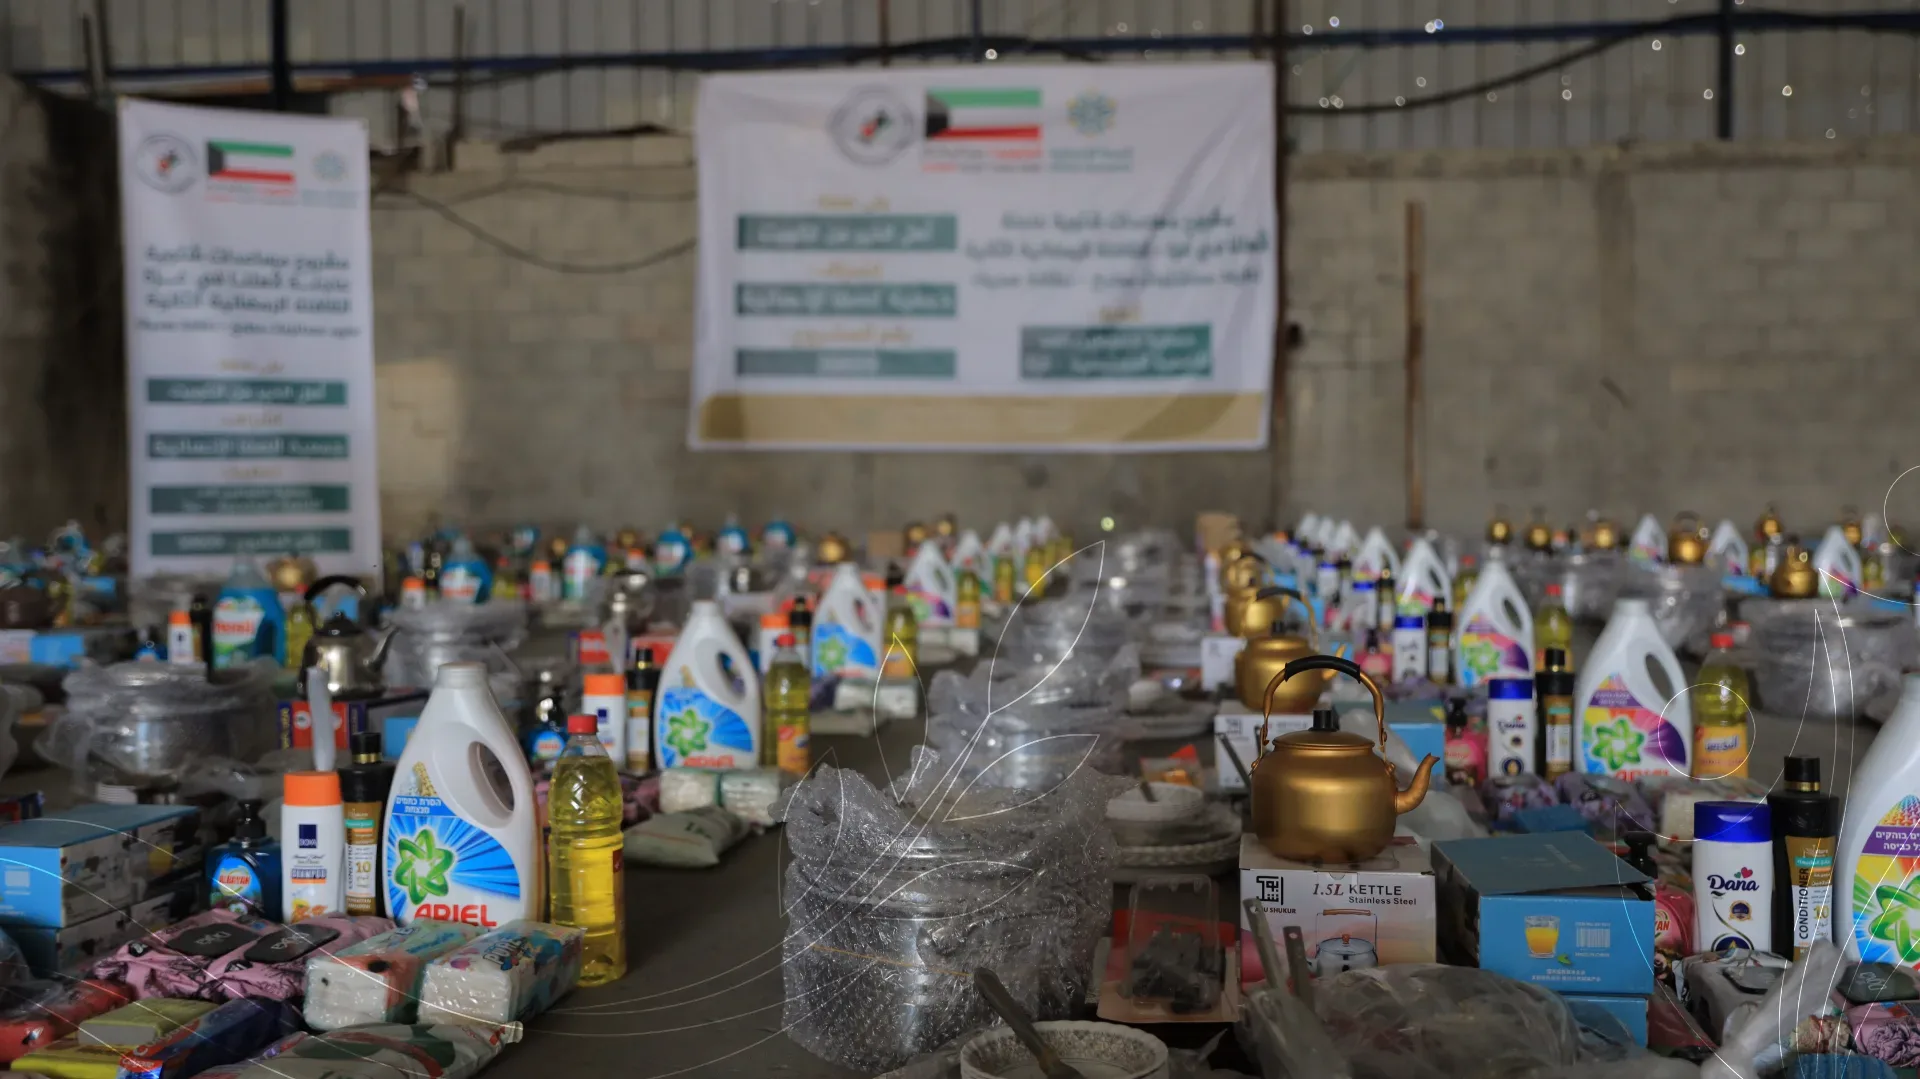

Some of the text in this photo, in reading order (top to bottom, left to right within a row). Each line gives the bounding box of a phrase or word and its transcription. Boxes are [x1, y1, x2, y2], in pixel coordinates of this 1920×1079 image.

[1312, 883, 1402, 896] 1.5L KETTLE
[1707, 874, 1760, 891] Dana
[1348, 896, 1417, 905] Stainless Steel
[1798, 867, 1809, 940] CONDITIONER
[414, 903, 497, 927] ARIEL
